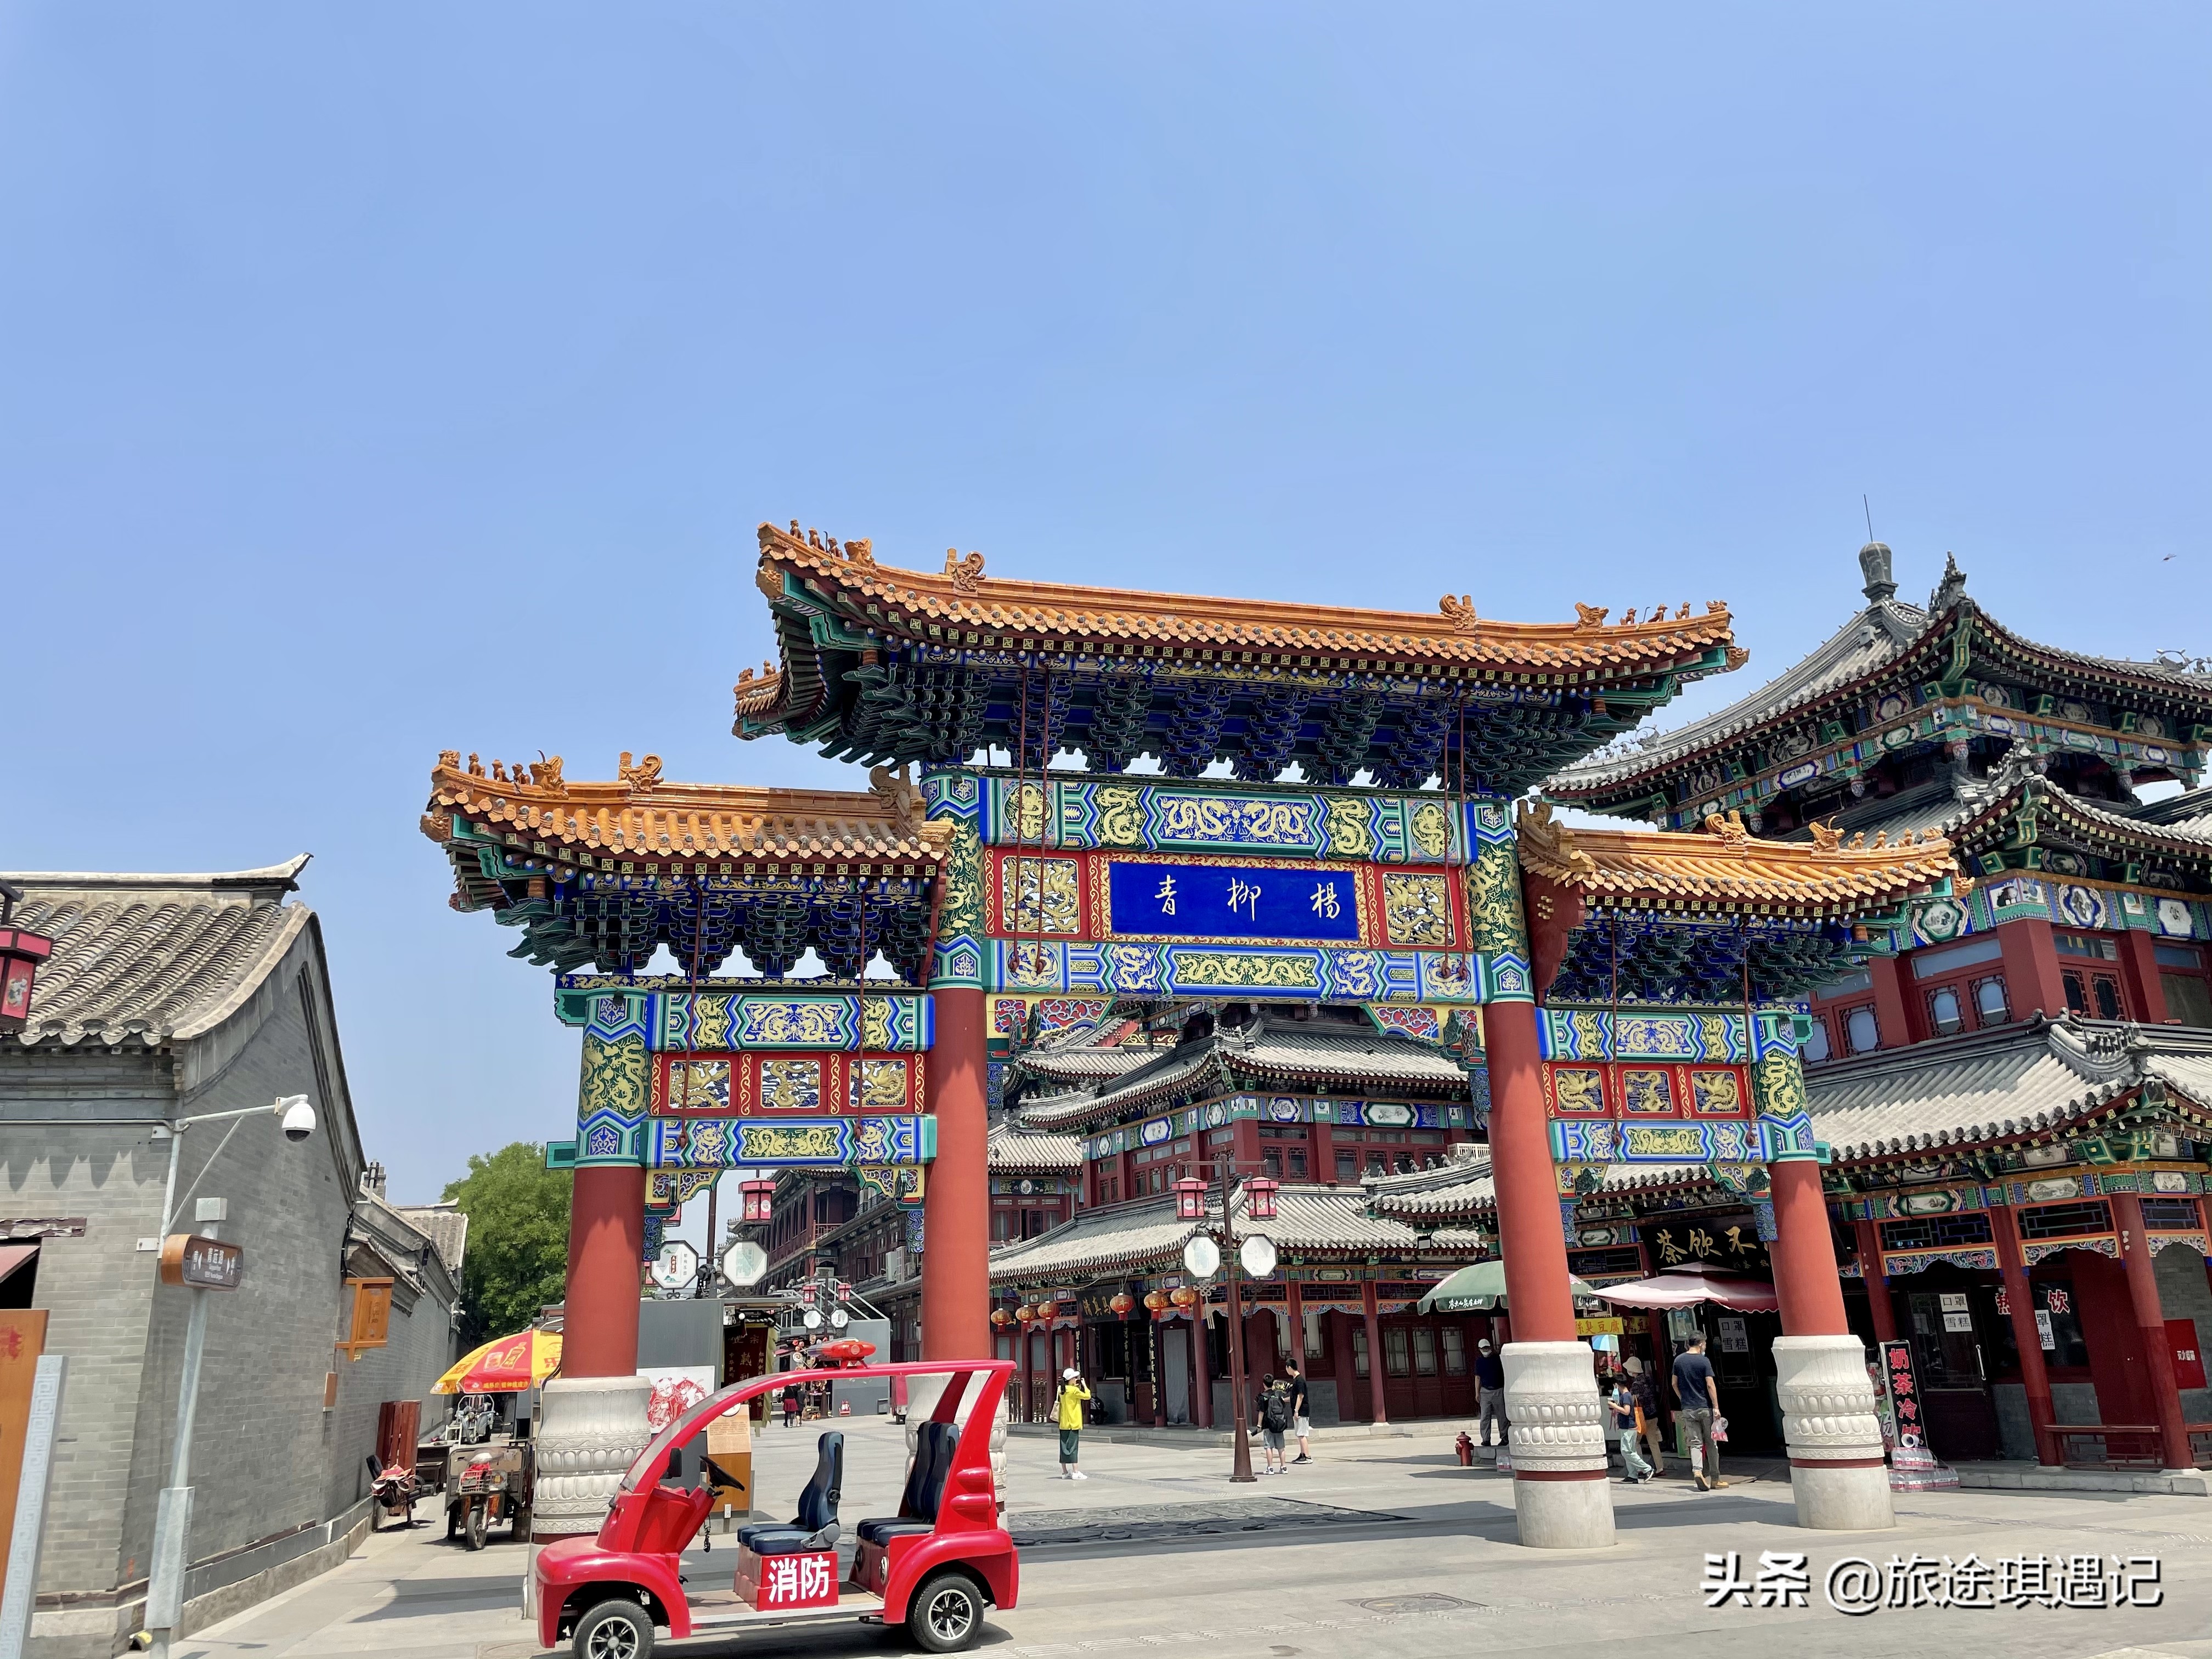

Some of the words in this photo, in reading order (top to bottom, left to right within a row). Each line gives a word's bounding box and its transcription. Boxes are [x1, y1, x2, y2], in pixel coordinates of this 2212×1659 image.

[1943, 1296, 1966, 1307] 口罩
[1945, 1317, 1970, 1328] 雪糕
[2036, 1313, 2049, 1327] 罩
[1722, 1321, 1743, 1332] 口罩
[1723, 1338, 1747, 1350] 雪糕
[2039, 1331, 2054, 1347] 糕
[768, 1554, 830, 1602] 消防
